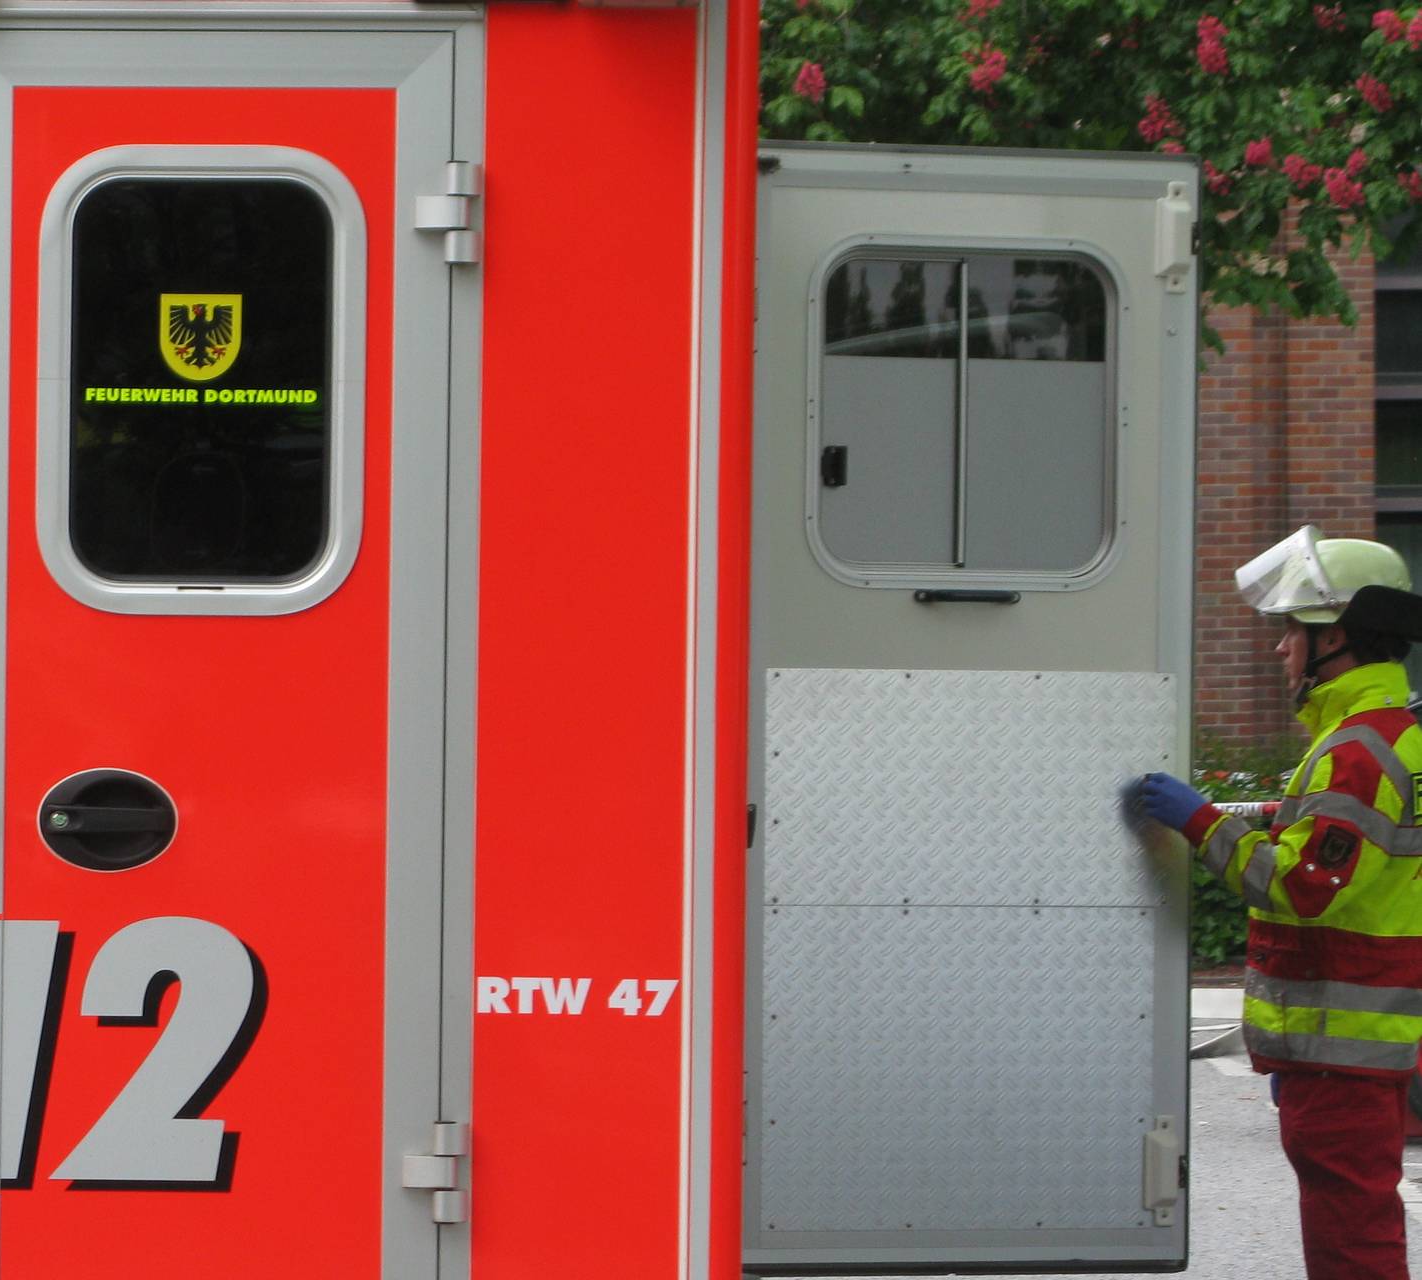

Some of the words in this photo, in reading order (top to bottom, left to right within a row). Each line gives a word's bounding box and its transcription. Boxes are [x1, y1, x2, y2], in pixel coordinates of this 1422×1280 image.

[85, 388, 198, 402] FEUERWEHR
[204, 389, 318, 403] DORTMUND
[477, 976, 592, 1015] RTW
[607, 979, 679, 1016] 47
